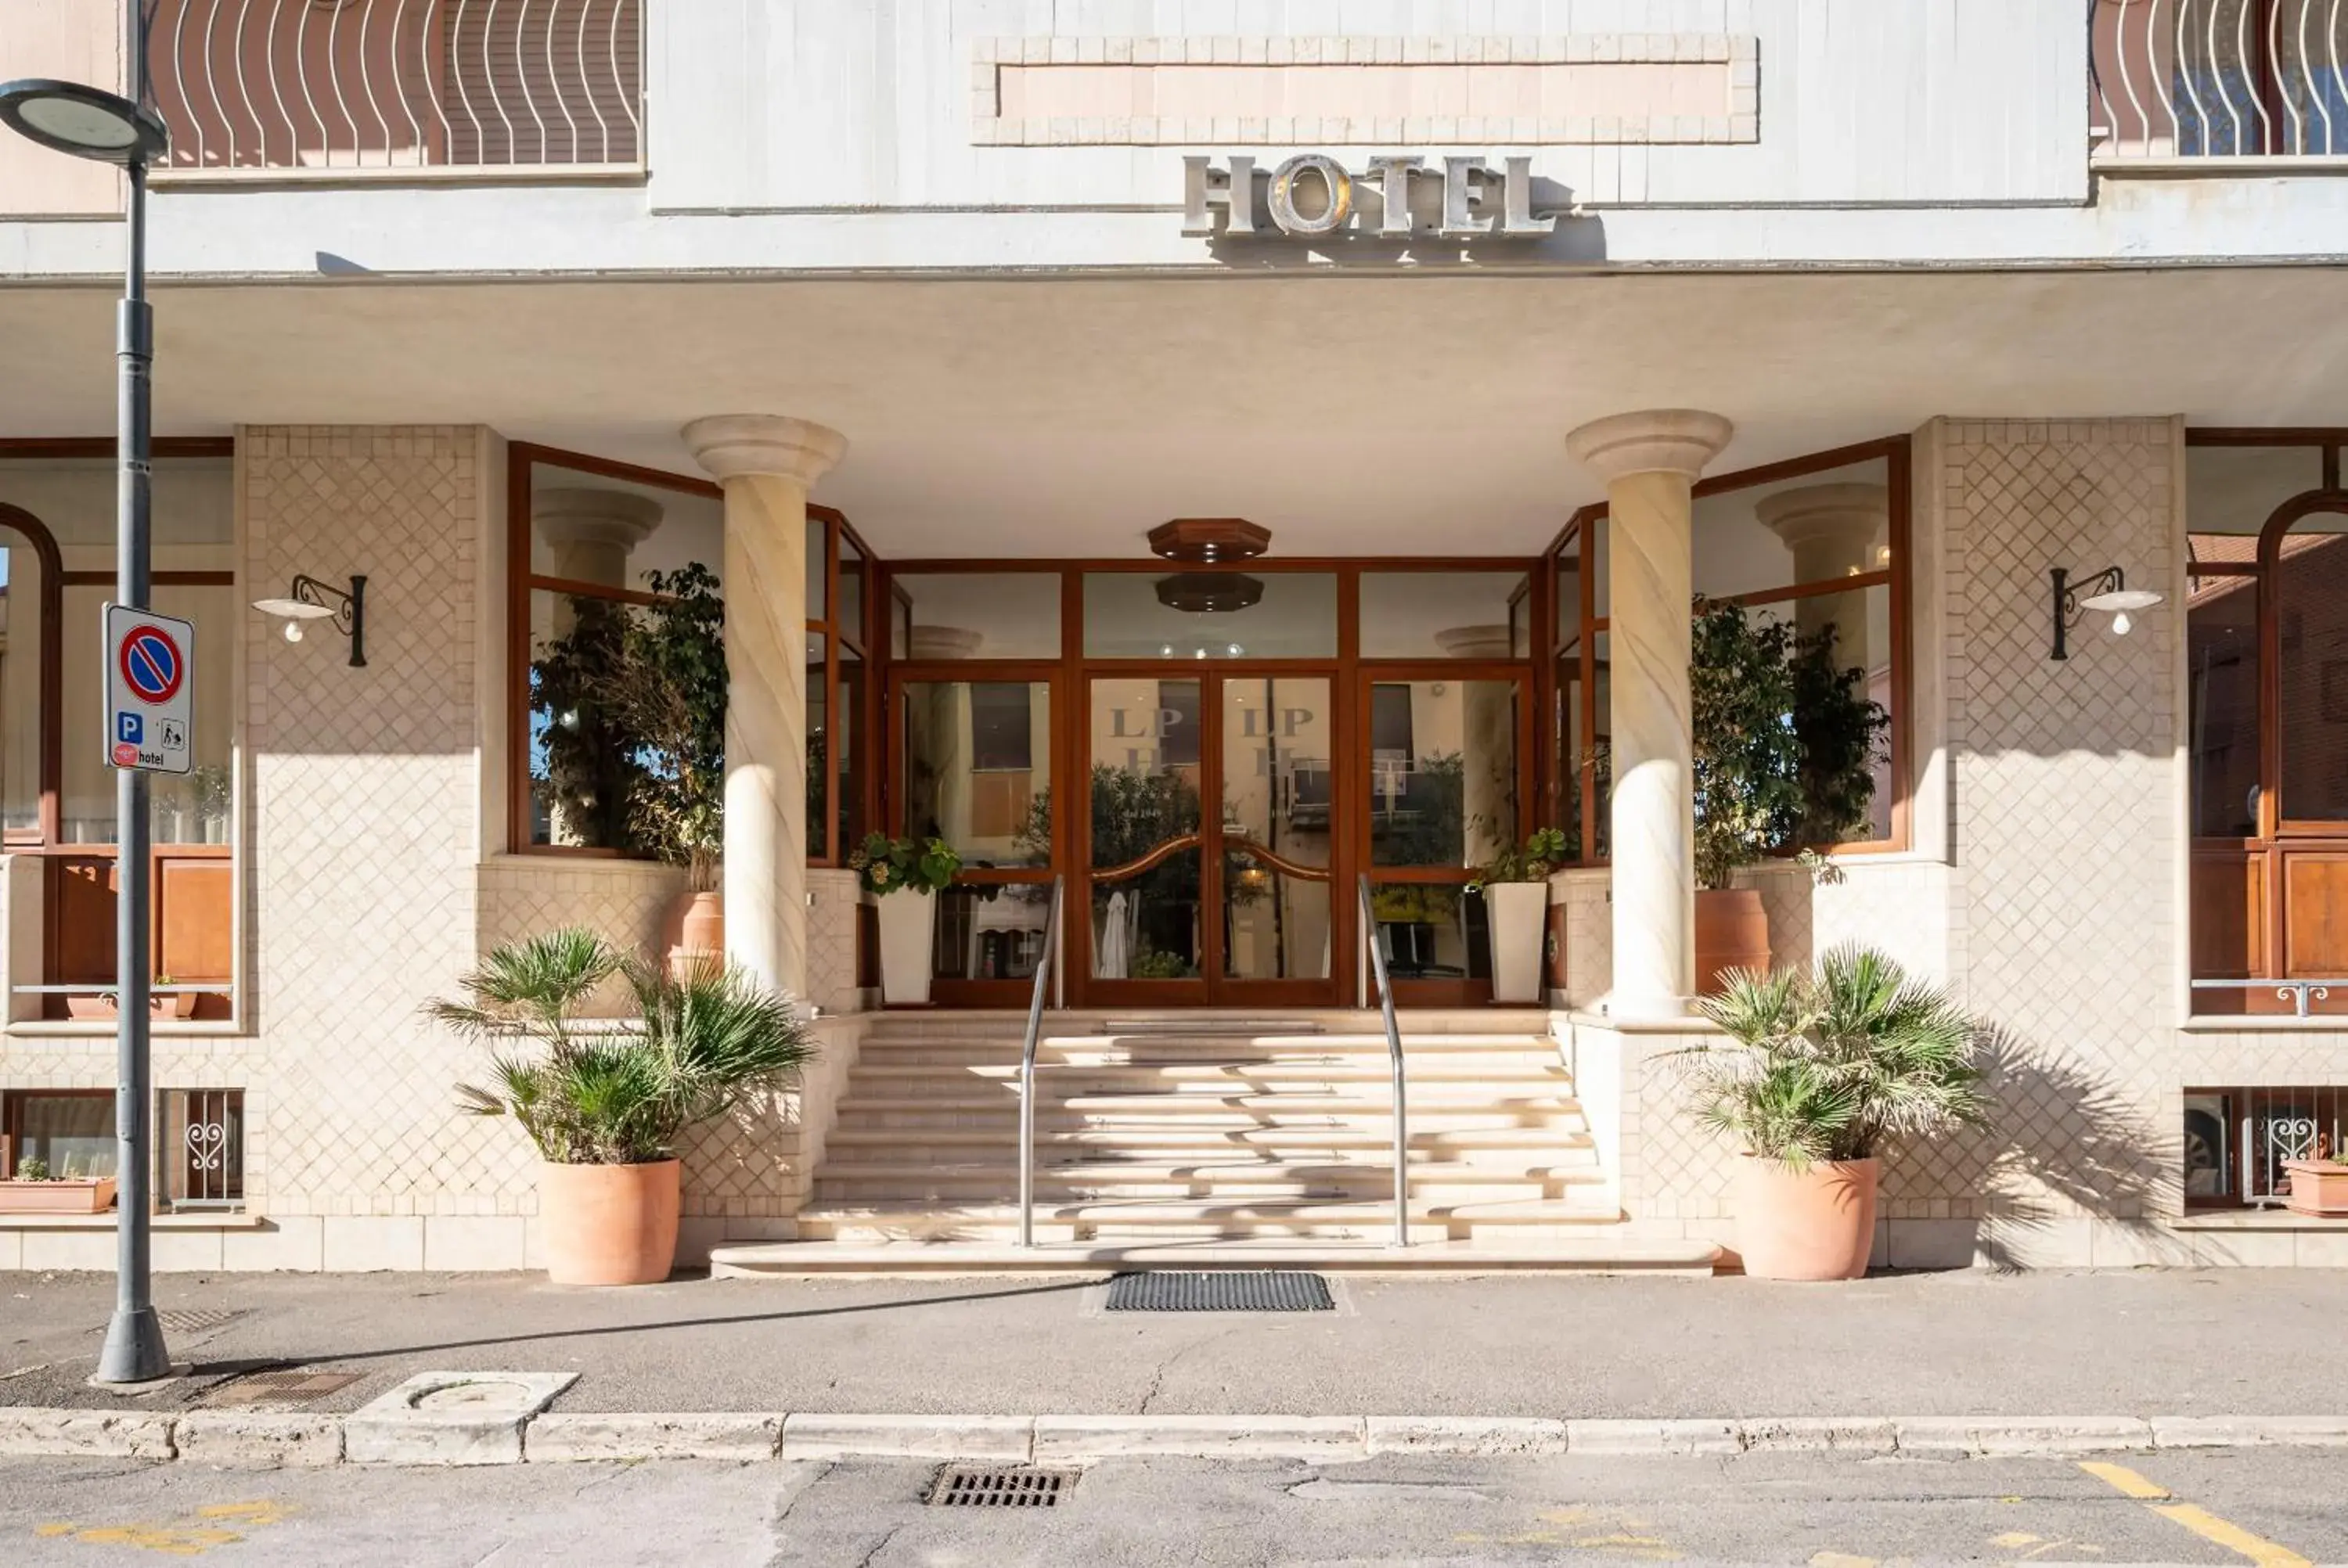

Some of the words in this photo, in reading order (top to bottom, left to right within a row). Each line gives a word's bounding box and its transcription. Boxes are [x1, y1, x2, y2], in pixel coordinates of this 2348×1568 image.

[1181, 153, 1556, 238] HOTEL
[123, 716, 138, 739] P
[139, 751, 164, 765] hotel
